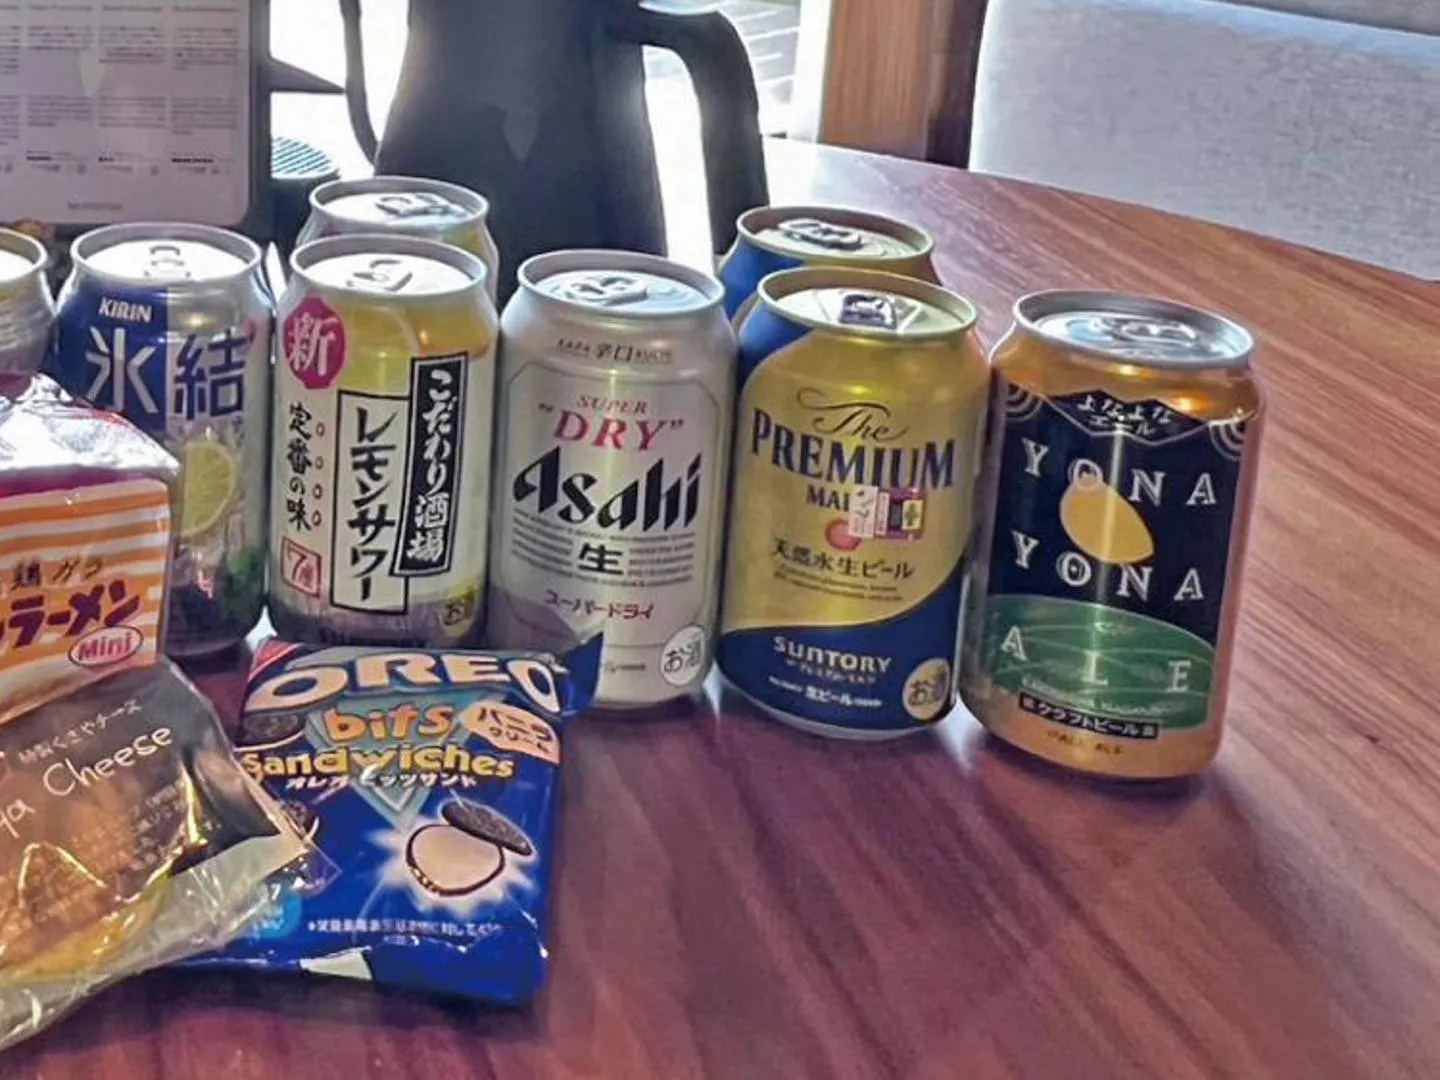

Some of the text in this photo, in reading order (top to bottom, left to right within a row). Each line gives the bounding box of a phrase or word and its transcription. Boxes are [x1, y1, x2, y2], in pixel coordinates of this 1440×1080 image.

[98, 296, 154, 323] KIRIN
[84, 326, 256, 421] 氷結
[284, 316, 337, 378] 新
[751, 407, 957, 489] PREMIUM
[796, 387, 910, 442] The
[287, 402, 313, 532] 定番の味
[405, 369, 456, 564] こだわり酒場
[512, 444, 702, 533] Asahi
[1021, 437, 1218, 507] YONA
[348, 406, 398, 602] レモンサワー
[578, 542, 624, 576] 生
[1011, 530, 1205, 602] YONA
[78, 631, 133, 662] Mini
[244, 651, 561, 714] OREO
[323, 705, 455, 742] bits
[43, 727, 172, 796] Cheese
[242, 740, 515, 782] Sandwiches
